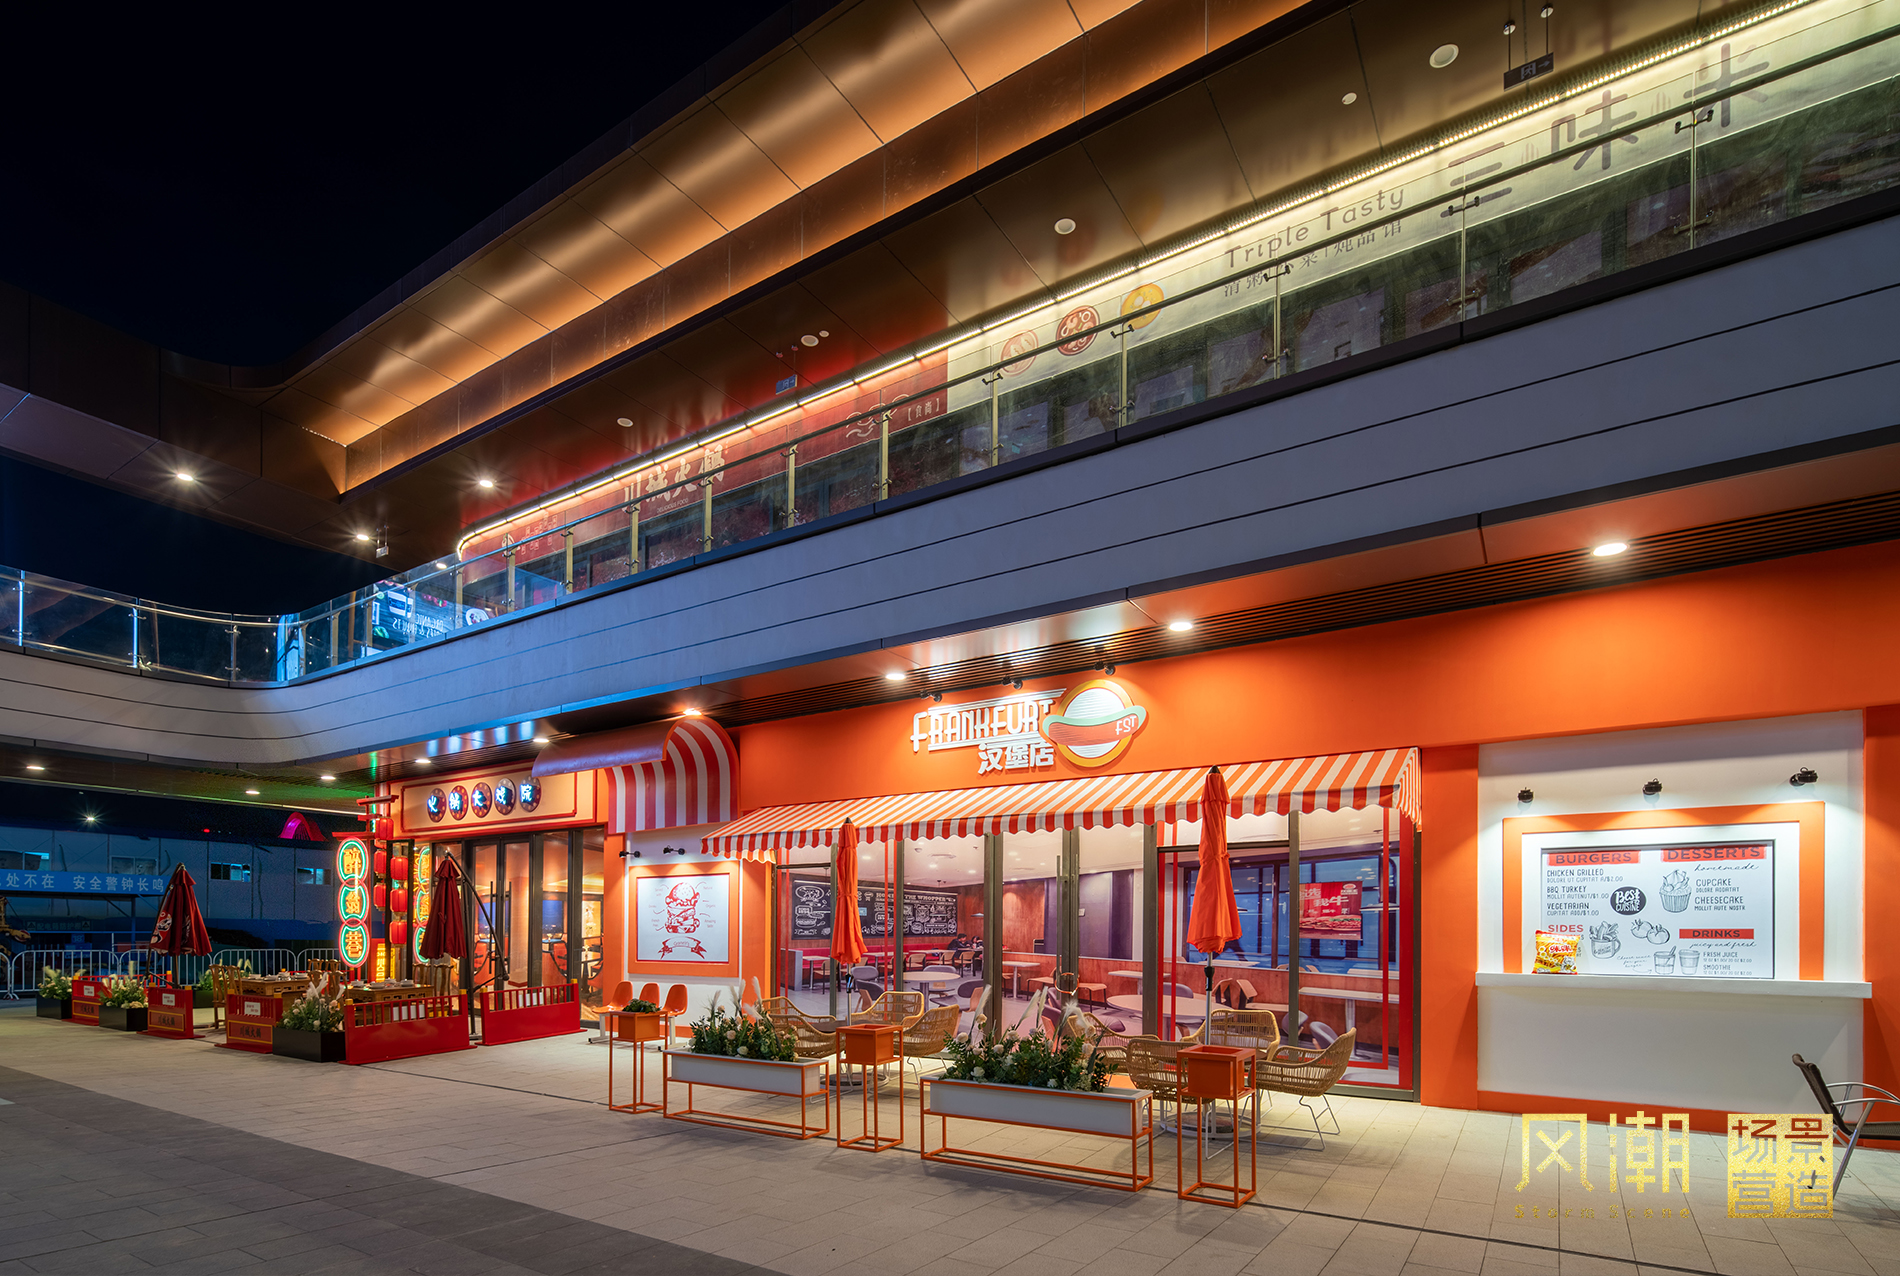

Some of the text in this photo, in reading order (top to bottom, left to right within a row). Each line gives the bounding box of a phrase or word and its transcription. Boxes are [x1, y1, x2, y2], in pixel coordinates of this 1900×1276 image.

[1224, 188, 1404, 268] Triple Tasty
[677, 497, 689, 506] FOOD
[910, 700, 1054, 752] FRANKFURT
[978, 742, 1054, 774] 汉堡店
[1667, 846, 1760, 860] DESSERTS
[1556, 853, 1632, 864] BURGERS
[1694, 863, 1759, 871] homemade
[1547, 868, 1604, 877] CHICKEN GRILLED
[0, 872, 165, 893] 处不在 安全警钟长鸣
[1695, 878, 1731, 887] CUPCAKE
[1562, 885, 1587, 893] TURKEY
[1614, 888, 1641, 904] Best
[1694, 896, 1744, 904] CHEESECAKE
[1547, 902, 1590, 910] VEGETARIAN
[1616, 901, 1640, 912] CUISINE
[1548, 924, 1584, 933] SIDES
[1692, 930, 1740, 938] DRINKS
[1731, 941, 1757, 949] fresh
